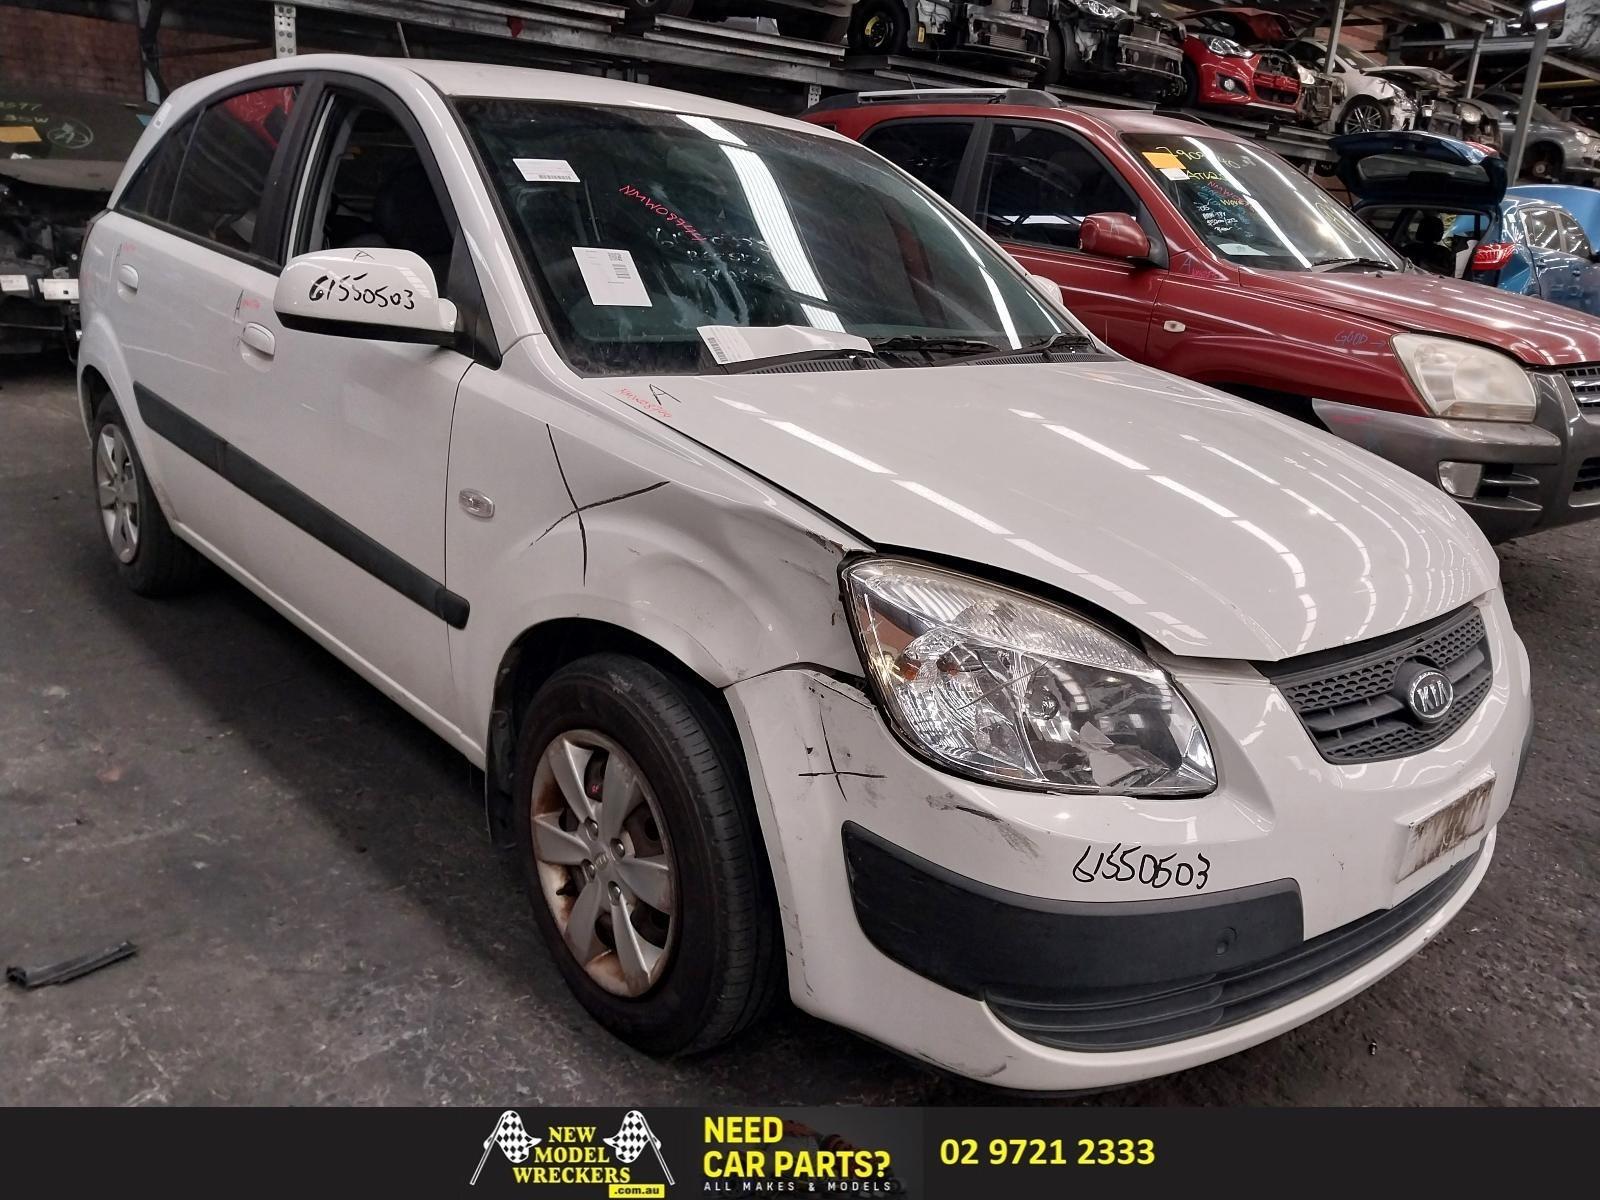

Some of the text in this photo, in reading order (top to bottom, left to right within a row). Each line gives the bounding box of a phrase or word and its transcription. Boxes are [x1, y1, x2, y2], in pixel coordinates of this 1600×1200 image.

[309, 272, 415, 310] 61550503
[649, 384, 681, 405] A
[1416, 680, 1450, 712] KIA
[1072, 842, 1210, 889] 61550503
